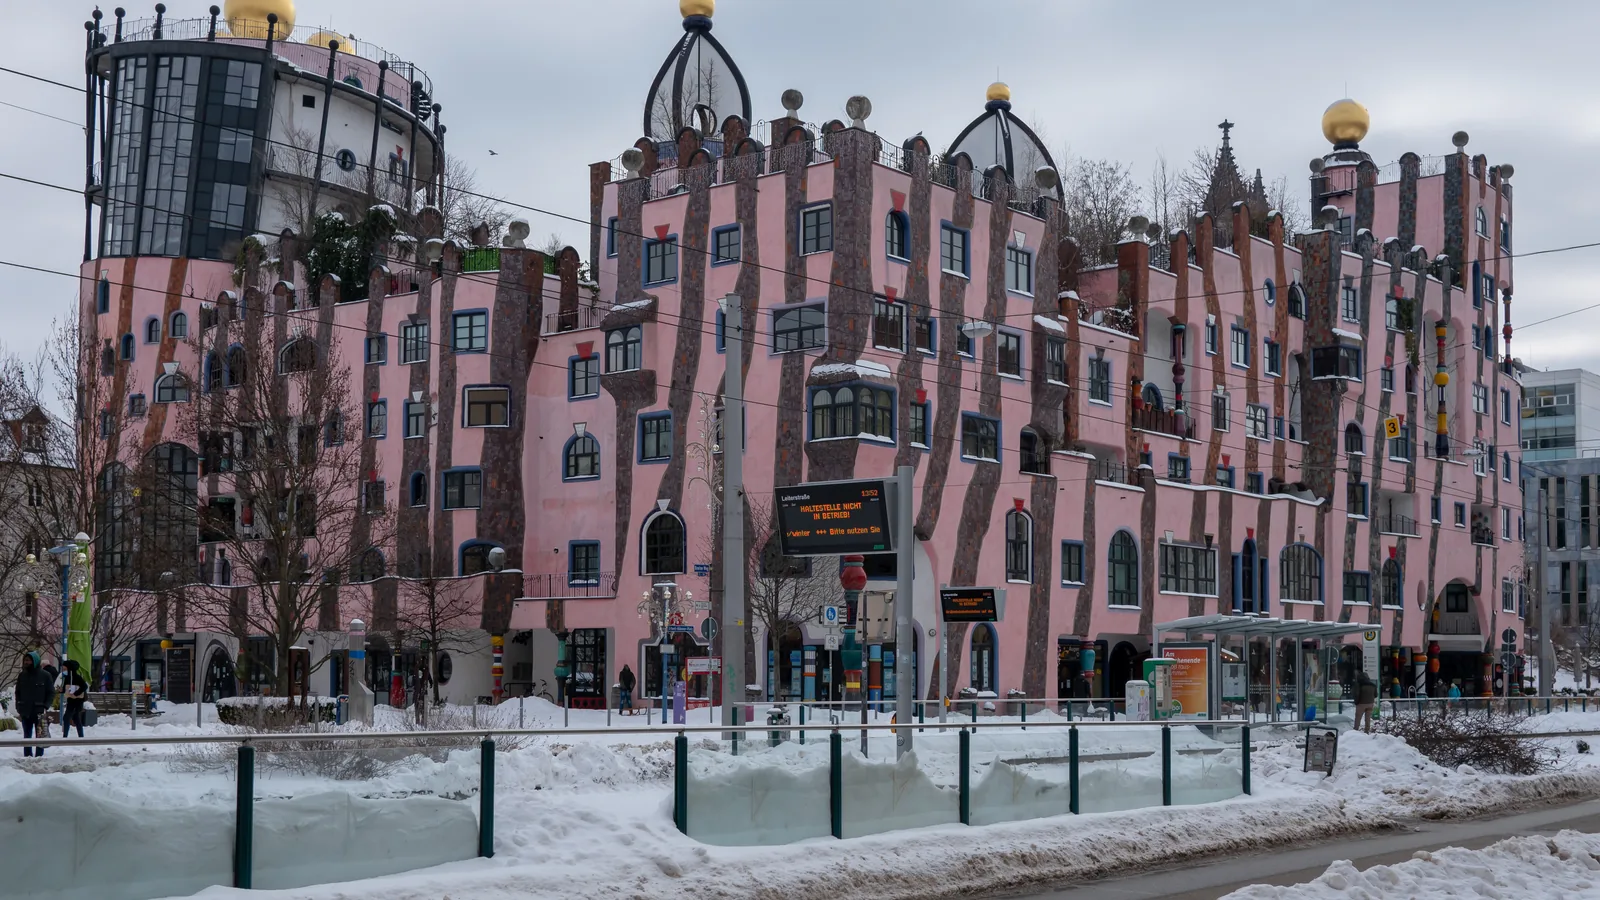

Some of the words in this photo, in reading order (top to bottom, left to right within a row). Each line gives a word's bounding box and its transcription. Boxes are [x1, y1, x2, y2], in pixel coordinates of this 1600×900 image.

[1388, 422, 1396, 433] 3
[800, 503, 841, 512] HALTESTELLE
[843, 502, 862, 510] NICHT
[822, 511, 850, 519] BETRIEB!
[829, 527, 845, 535] Bitte
[847, 527, 869, 535] nutzen
[870, 525, 881, 533] Sie
